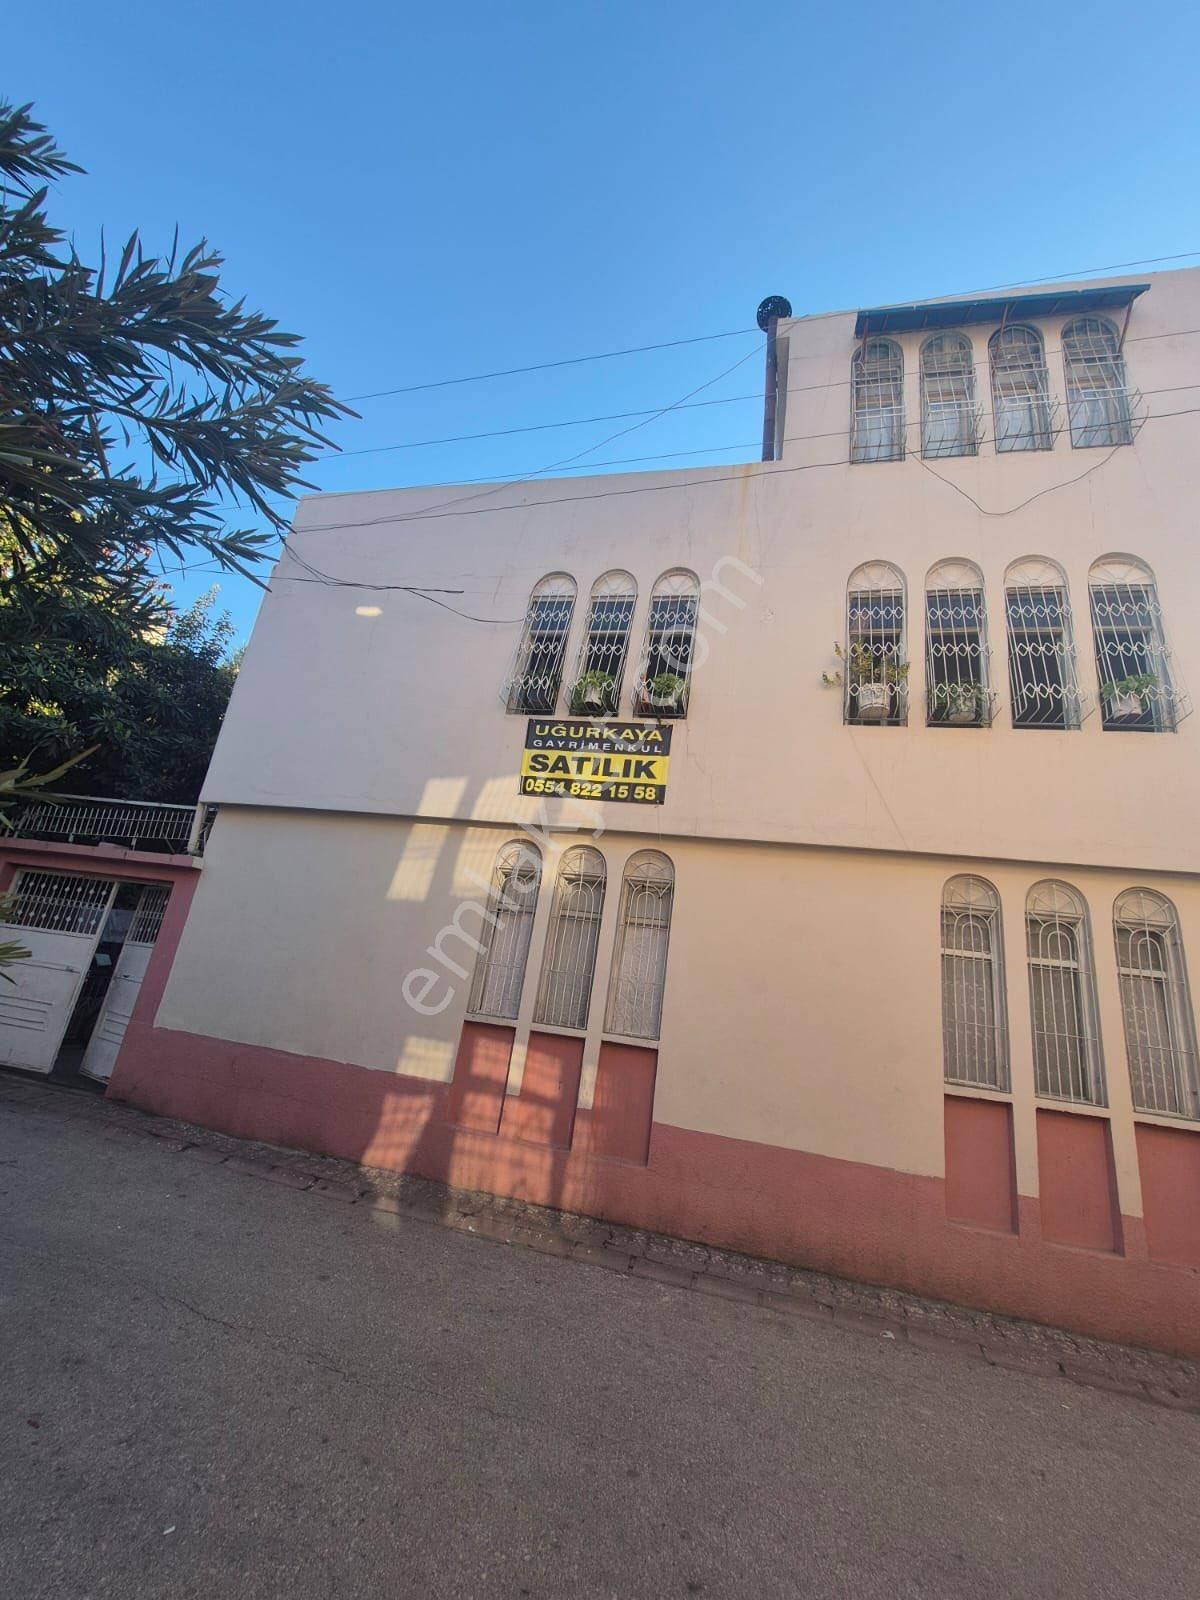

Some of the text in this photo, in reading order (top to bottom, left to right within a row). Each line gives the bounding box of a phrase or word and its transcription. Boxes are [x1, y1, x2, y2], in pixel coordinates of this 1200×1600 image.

[535, 724, 663, 742] UĞURKAYA
[533, 739, 662, 753] GAYRİMENKUL
[528, 754, 656, 779] SATILIK
[525, 778, 656, 801] 0554 822 15 58
